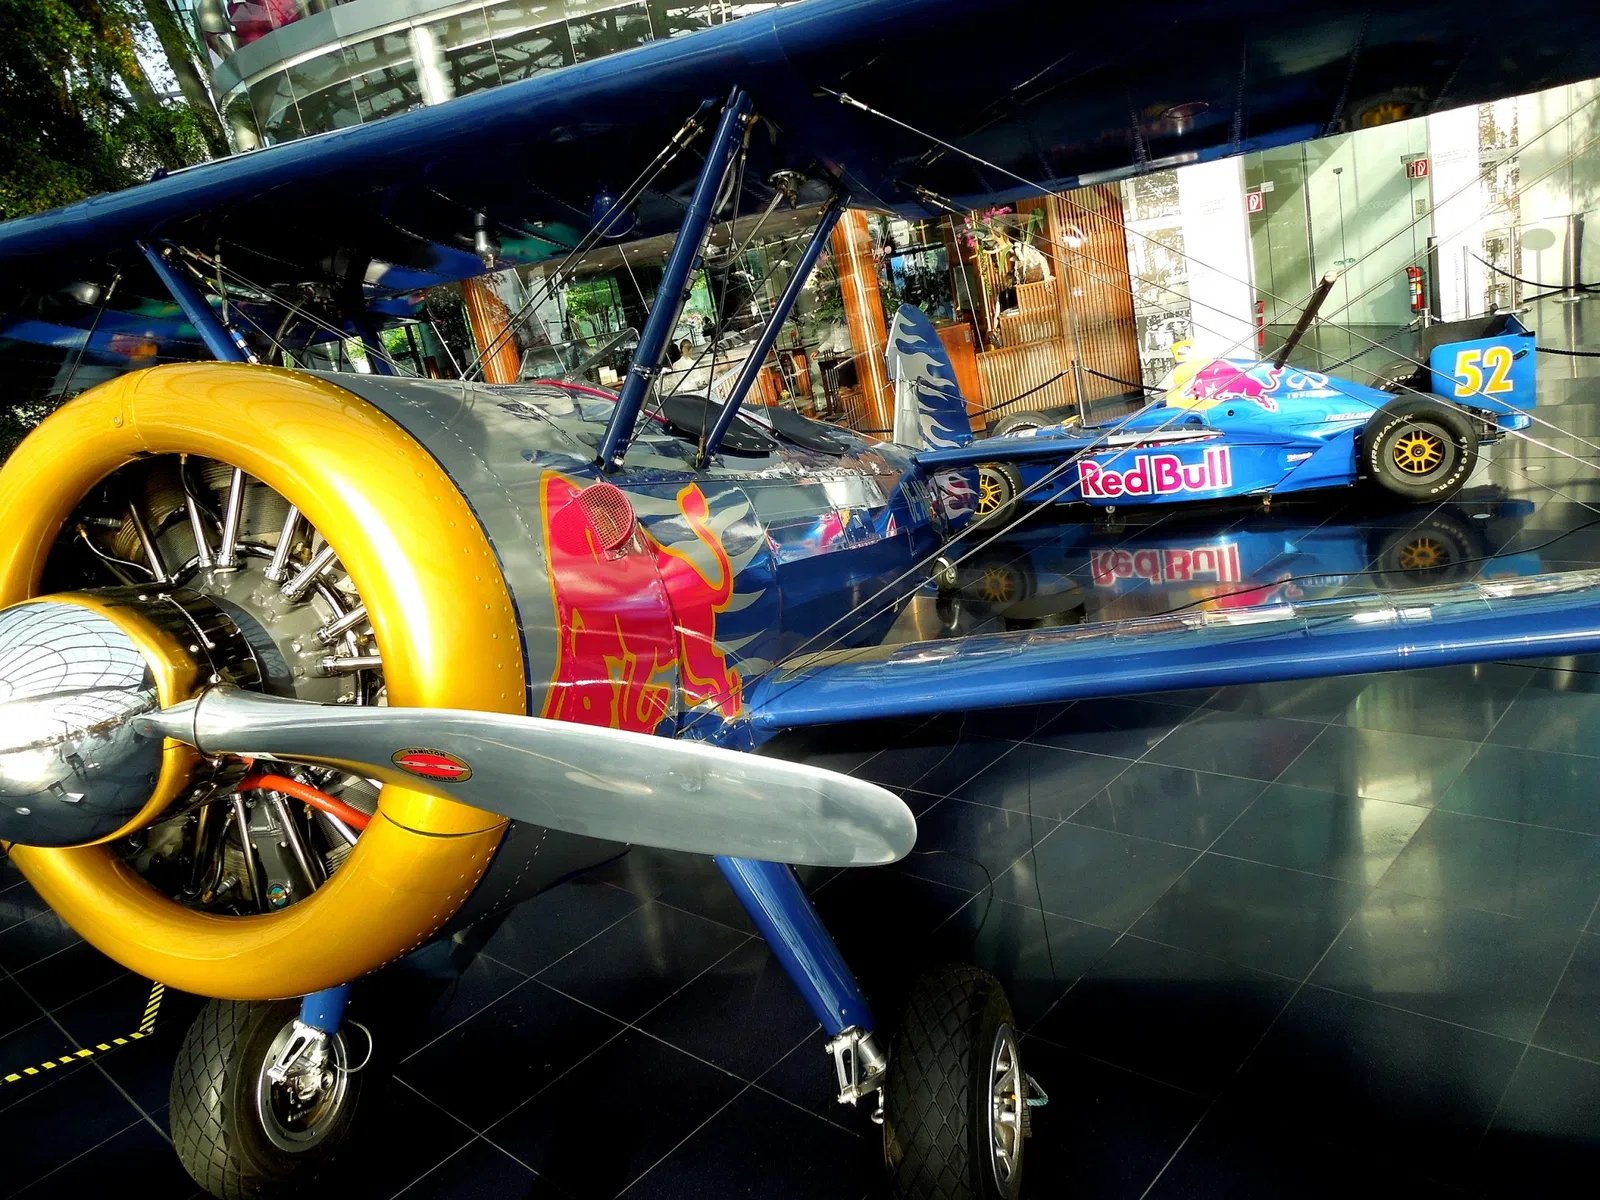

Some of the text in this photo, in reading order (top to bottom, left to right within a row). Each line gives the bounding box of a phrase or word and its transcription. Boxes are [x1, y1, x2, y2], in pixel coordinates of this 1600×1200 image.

[1454, 346, 1513, 397] 52
[1371, 413, 1413, 473] FIREHAWK
[1430, 436, 1468, 494] Firestone
[1078, 446, 1232, 498] Red Bull
[408, 749, 446, 758] HAMILTON
